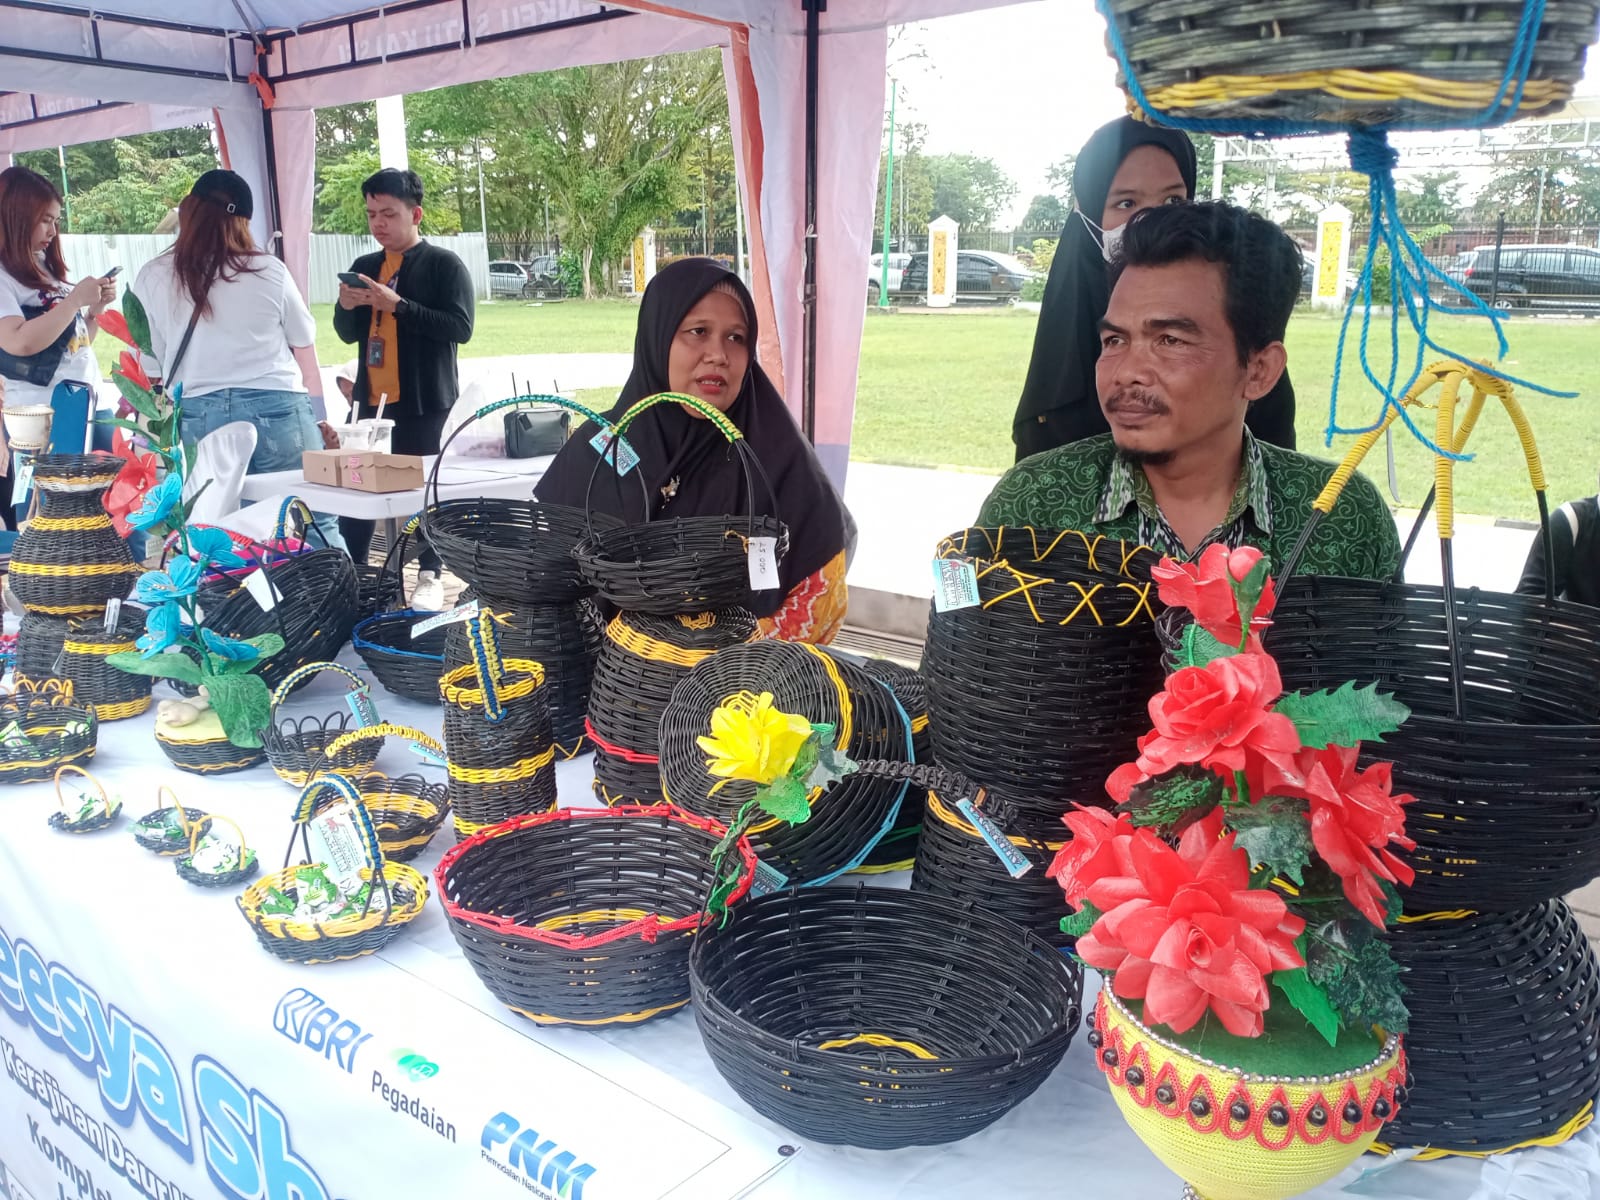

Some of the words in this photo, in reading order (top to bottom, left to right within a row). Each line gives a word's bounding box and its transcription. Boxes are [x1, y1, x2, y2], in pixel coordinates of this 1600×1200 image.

[304, 1007, 374, 1075] BRI
[0, 1034, 106, 1162] Kerajinan
[371, 1069, 457, 1144] Pegadaian
[480, 1111, 598, 1200] PNM
